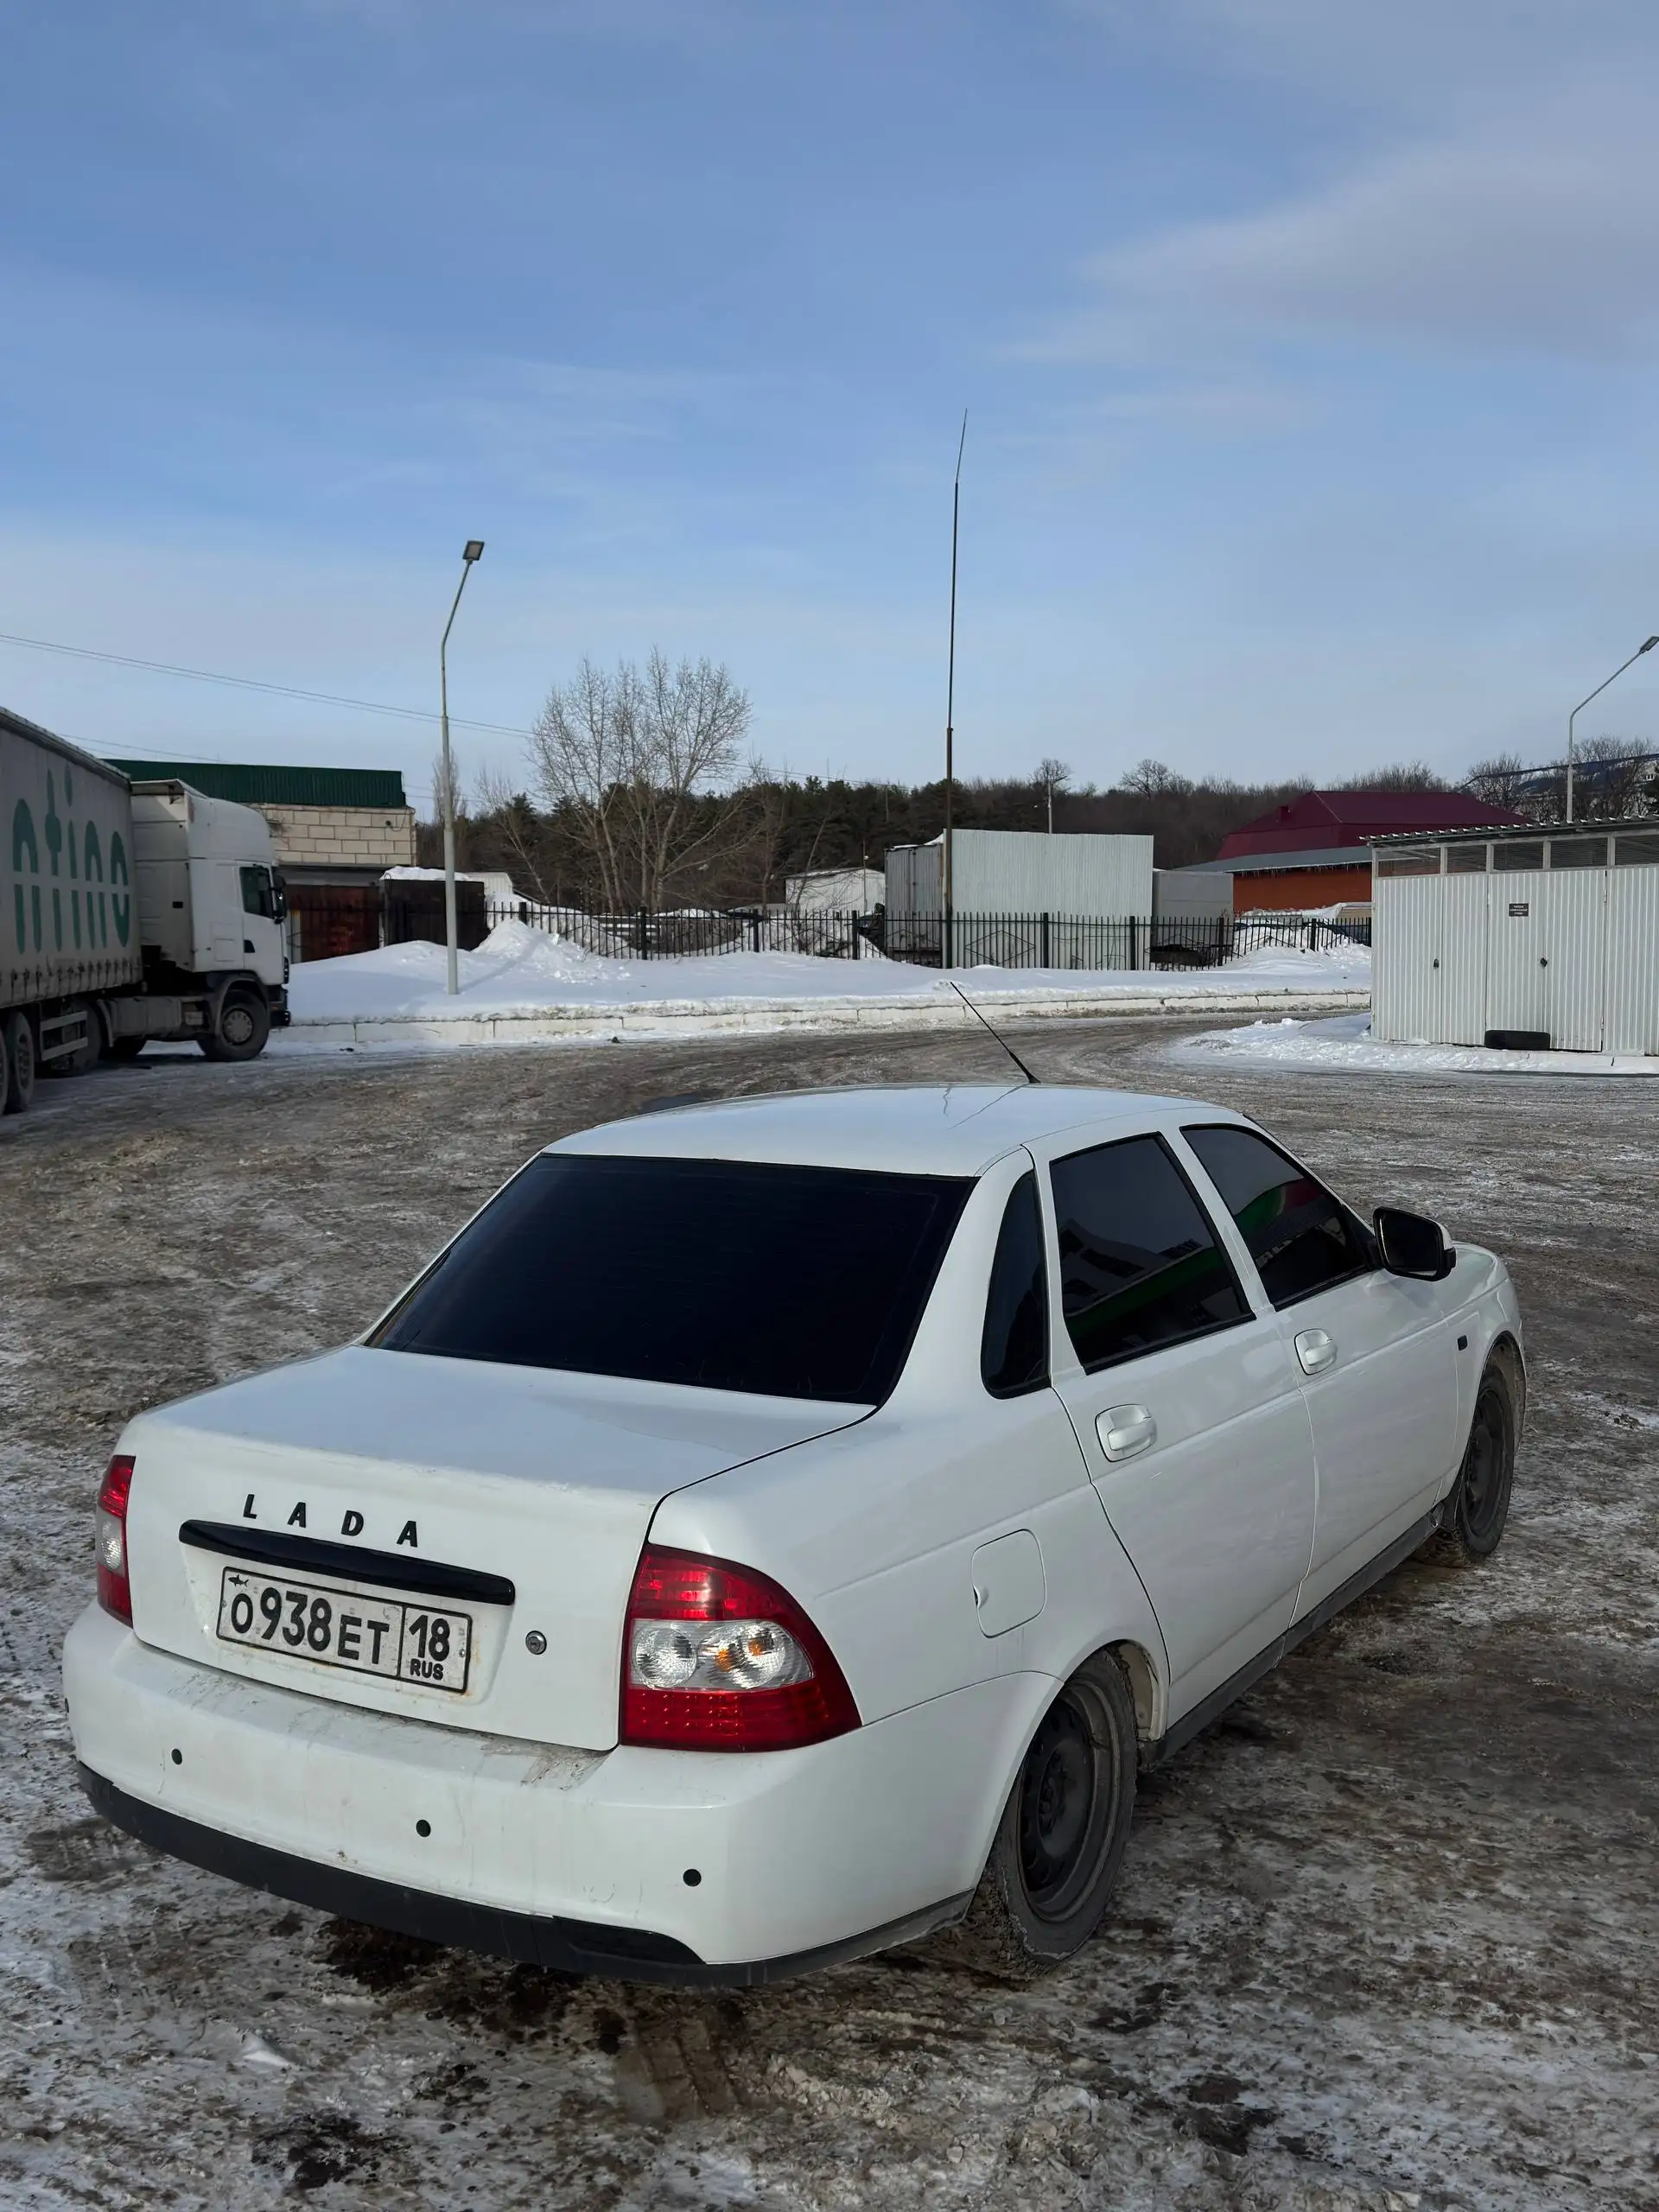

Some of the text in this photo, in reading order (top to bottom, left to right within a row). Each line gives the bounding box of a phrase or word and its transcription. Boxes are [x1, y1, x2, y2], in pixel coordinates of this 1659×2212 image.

[242, 1494, 418, 1548] LADA
[409, 1615, 450, 1662] 18
[410, 1658, 444, 1681] RUS
